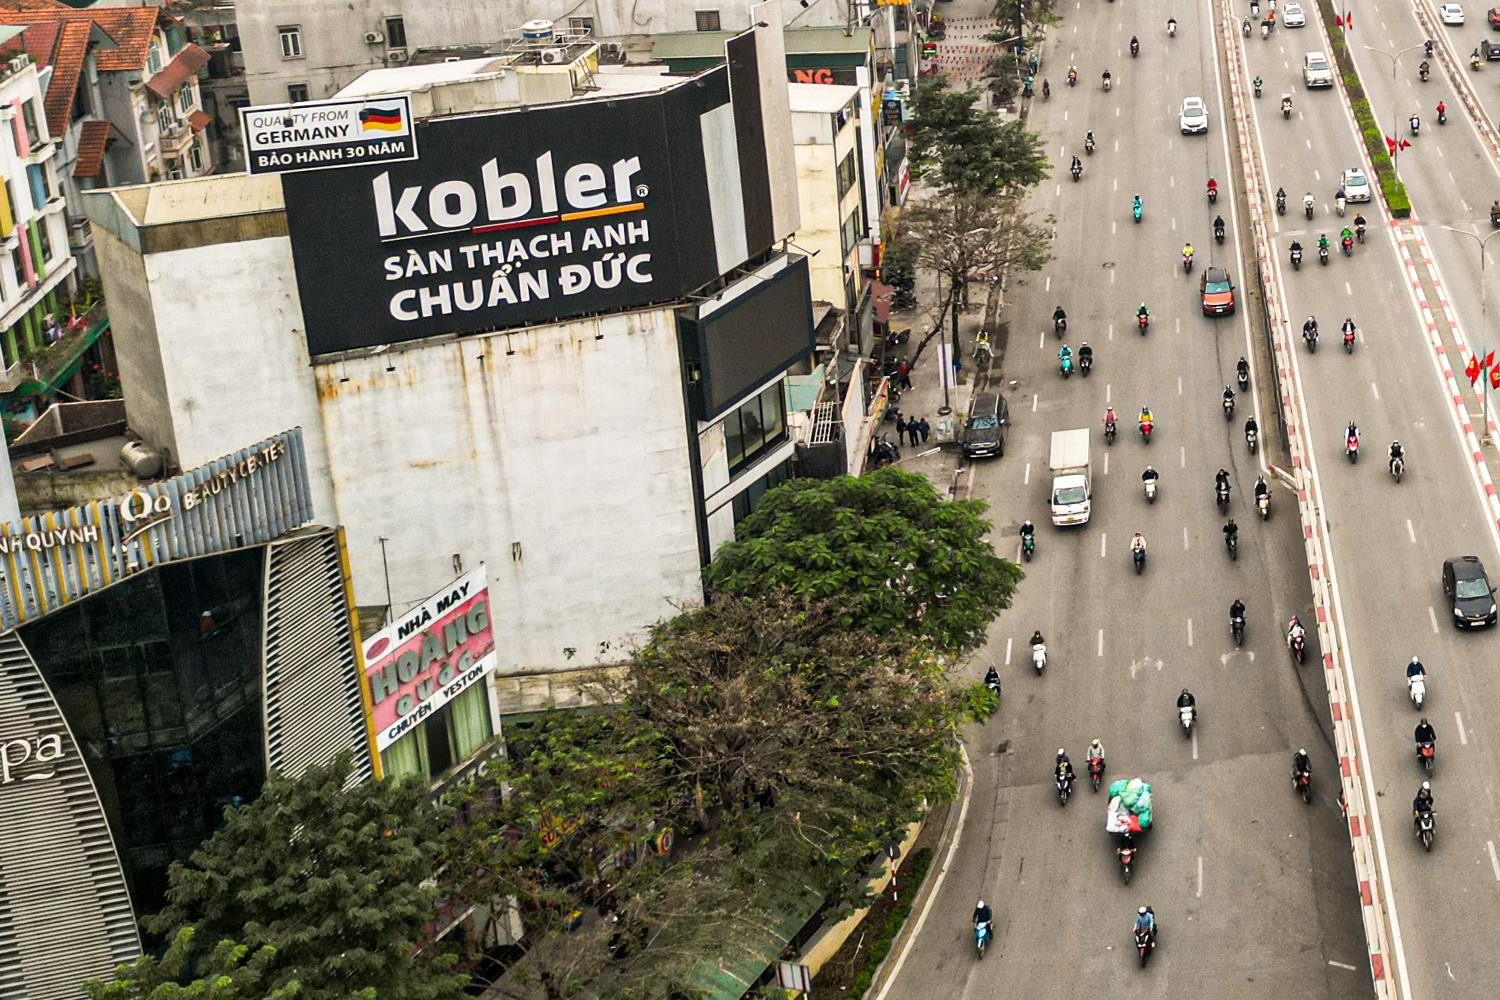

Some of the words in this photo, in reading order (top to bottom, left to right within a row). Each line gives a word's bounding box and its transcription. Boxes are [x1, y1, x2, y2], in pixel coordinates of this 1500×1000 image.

[788, 67, 834, 85] NG
[253, 110, 308, 129] QUATY
[311, 109, 349, 123] FROM
[255, 124, 350, 145] GERMANY
[258, 151, 293, 168] BẢO
[296, 148, 343, 164] HÀNH
[347, 145, 365, 158] 30
[368, 141, 405, 156] NĂM
[372, 150, 642, 238] kobler
[384, 248, 452, 281] SÀN
[459, 230, 573, 270] THẠCH
[582, 219, 650, 251] ANH
[389, 264, 550, 321] CHUẨN
[558, 252, 653, 296] ĐỨC
[183, 468, 238, 510] BEAUTY
[397, 606, 432, 640] NHÀ
[436, 582, 470, 614] MAY
[370, 601, 488, 705] HOÀNG
[388, 702, 432, 739] CHUYÊN
[442, 664, 483, 698] VESTON
